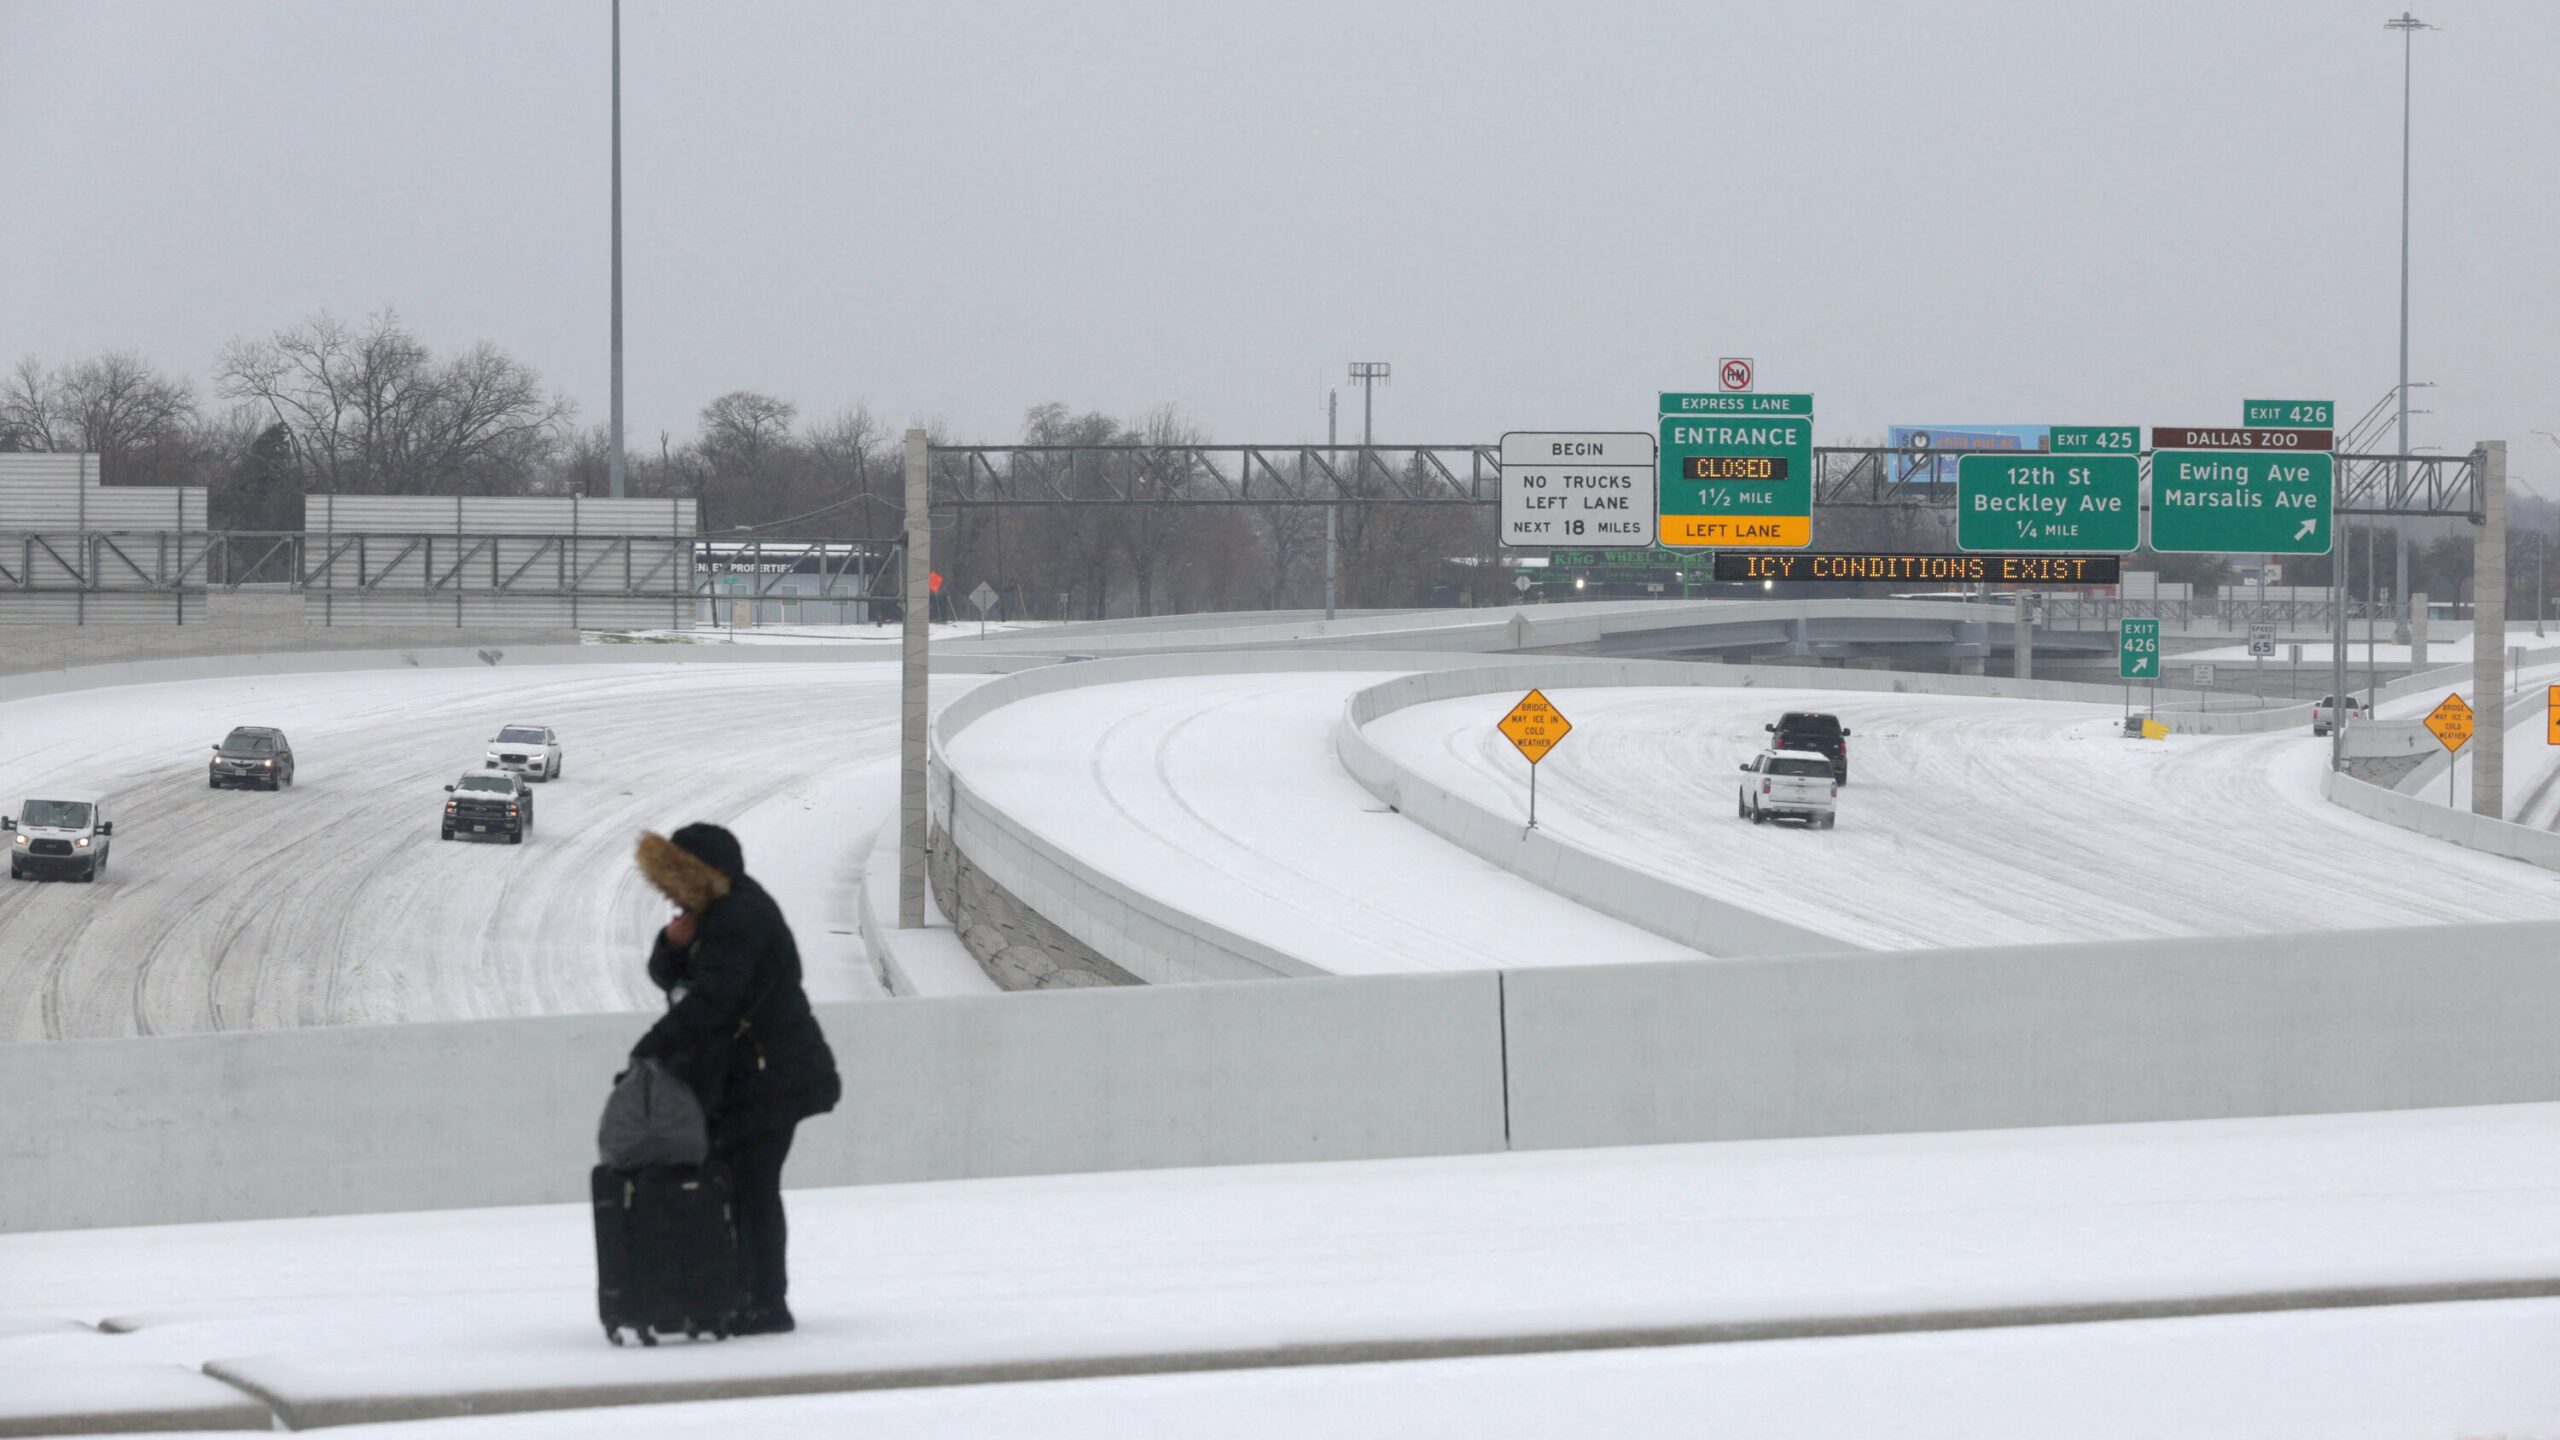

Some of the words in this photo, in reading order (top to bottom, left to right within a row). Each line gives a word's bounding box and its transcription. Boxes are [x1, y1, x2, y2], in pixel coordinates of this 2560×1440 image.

[1682, 398, 1744, 410] EXPRESS
[1752, 398, 1790, 410] LANE
[2251, 407, 2281, 420] EXIT
[2290, 406, 2328, 422] 426
[1674, 428, 1797, 445] ENTRANCE
[2058, 434, 2088, 446] EXIT
[2096, 432, 2132, 449] 425
[2186, 432, 2252, 446] DALLAS
[2261, 432, 2298, 446] ZOO
[1552, 444, 1604, 456] BEGIN
[1697, 459, 1771, 478] CLOSED
[2180, 462, 2250, 486] Ewing
[2268, 464, 2310, 482] Ave
[1524, 476, 1546, 489] NO
[1564, 476, 1632, 489] TRUCKS
[2007, 468, 2055, 486] 12th
[2068, 468, 2091, 486] St
[1526, 497, 1568, 510] LEFT
[1584, 497, 1629, 510] LANE
[1740, 492, 1773, 504] MILE
[1974, 493, 2068, 516] Beckley
[2080, 494, 2122, 512] Ave
[2164, 490, 2262, 508] Marsalis
[2275, 491, 2318, 509] Ave
[1514, 522, 1551, 533] NEXT
[1564, 520, 1585, 536] 18
[1598, 522, 1641, 534] MILES
[1686, 524, 1728, 537] LEFT
[1736, 524, 1781, 538] LANE
[2046, 524, 2078, 537] MILE
[1747, 557, 1796, 577] ICY
[1814, 558, 1983, 578] CONDITIONS
[2003, 559, 2086, 580] EXIST
[2124, 623, 2154, 634] EXIT
[2124, 638, 2156, 652] 426
[2253, 642, 2272, 652] 65
[1521, 703, 1548, 712] BRIDGE
[2442, 704, 2464, 712] BRIDGE
[1512, 715, 1527, 723] MAY
[1532, 715, 1544, 724] ICE
[1550, 715, 1558, 724] IN
[1524, 727, 1545, 736] COLD
[1518, 738, 1551, 747] WEATHER
